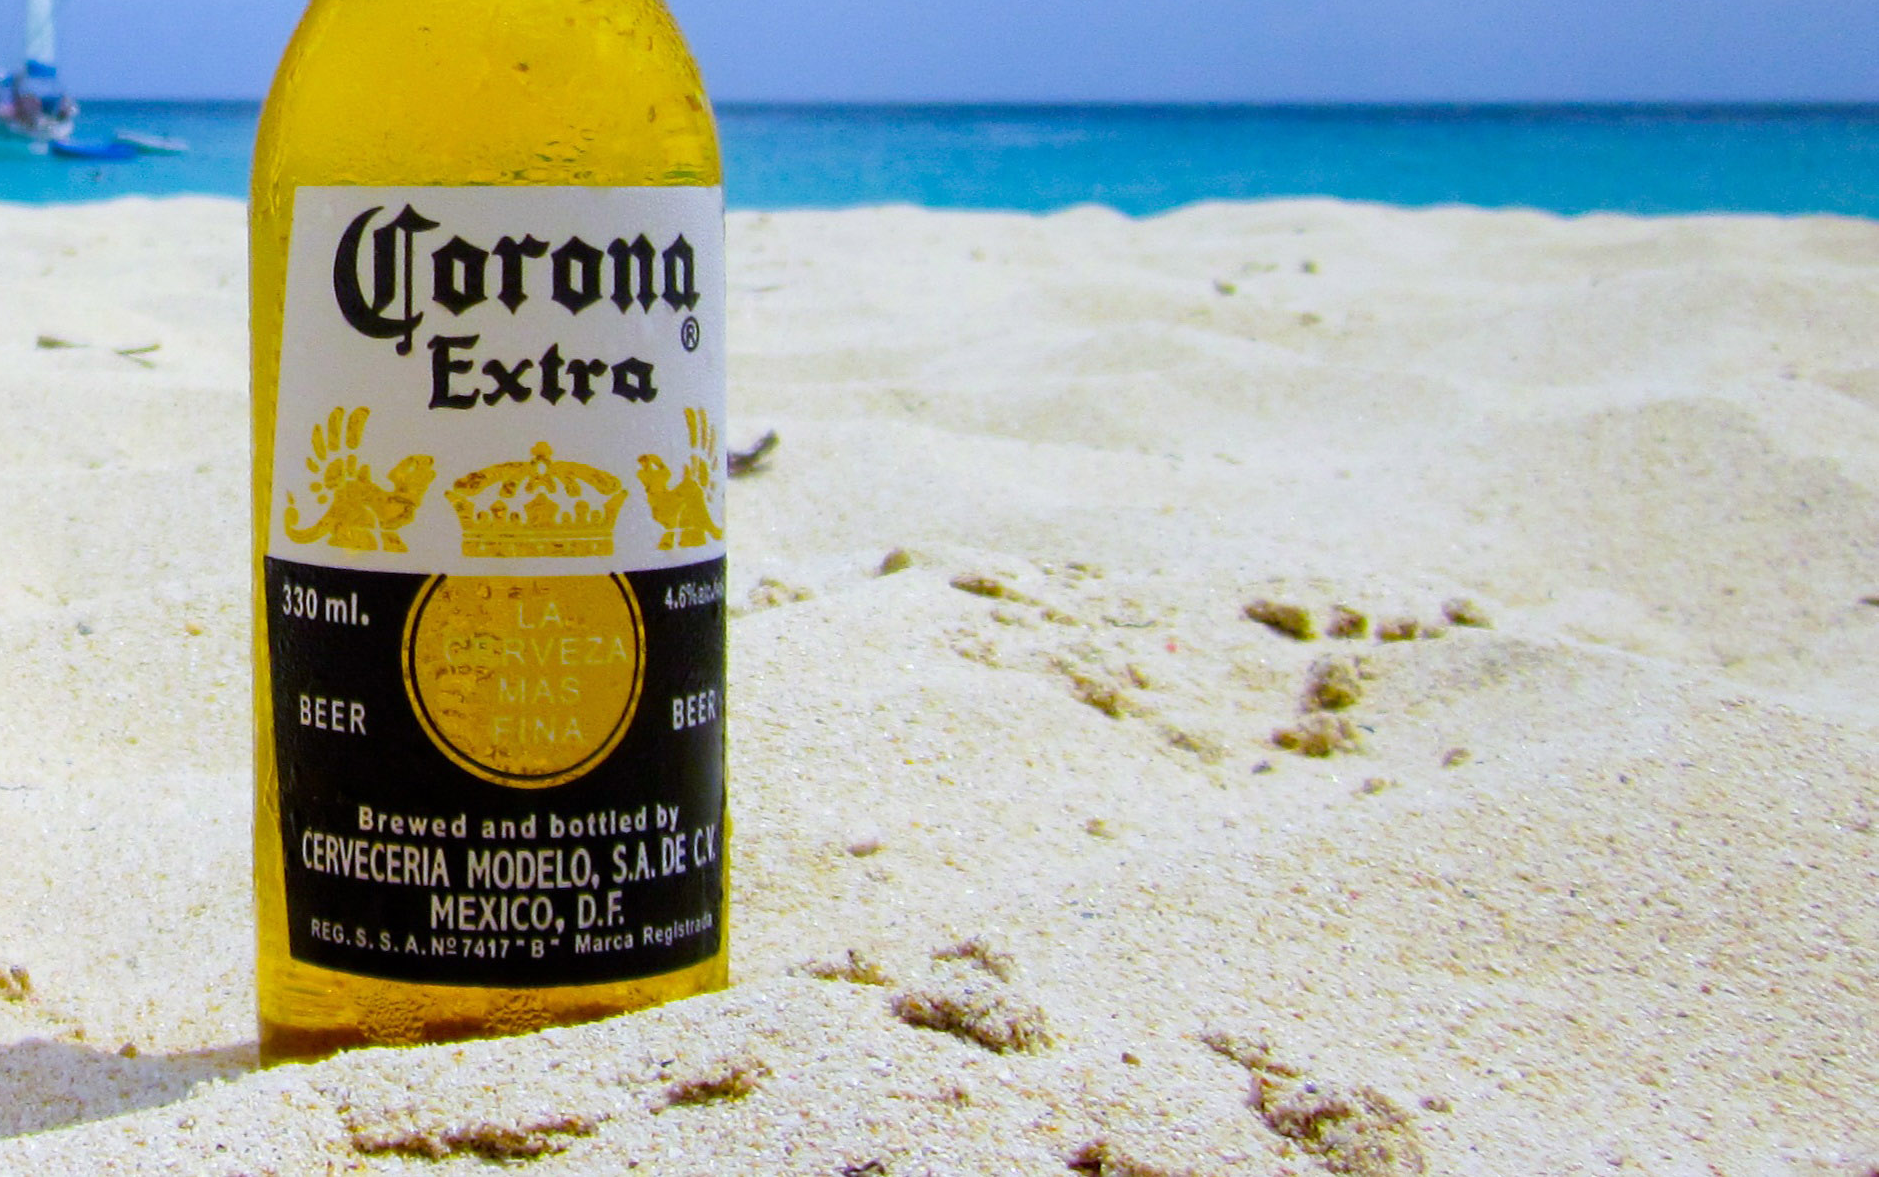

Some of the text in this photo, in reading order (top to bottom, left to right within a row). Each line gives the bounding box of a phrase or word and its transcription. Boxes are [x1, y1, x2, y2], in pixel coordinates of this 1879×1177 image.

[333, 203, 701, 356] Corona
[428, 334, 658, 410] Extra
[282, 584, 370, 626] 330 ml.
[518, 602, 563, 629] LA
[499, 677, 580, 704] MAS
[672, 689, 717, 731] BEER
[300, 694, 367, 736] BEER
[494, 717, 586, 743] FINA
[358, 803, 680, 840] Brewed and bottled by
[302, 824, 717, 890] CERVECERIA MODELO, S.A. DE C.V.
[430, 890, 626, 935] MEXICO, D.F.
[575, 933, 634, 954] Marca
[642, 912, 714, 947] Registrada
